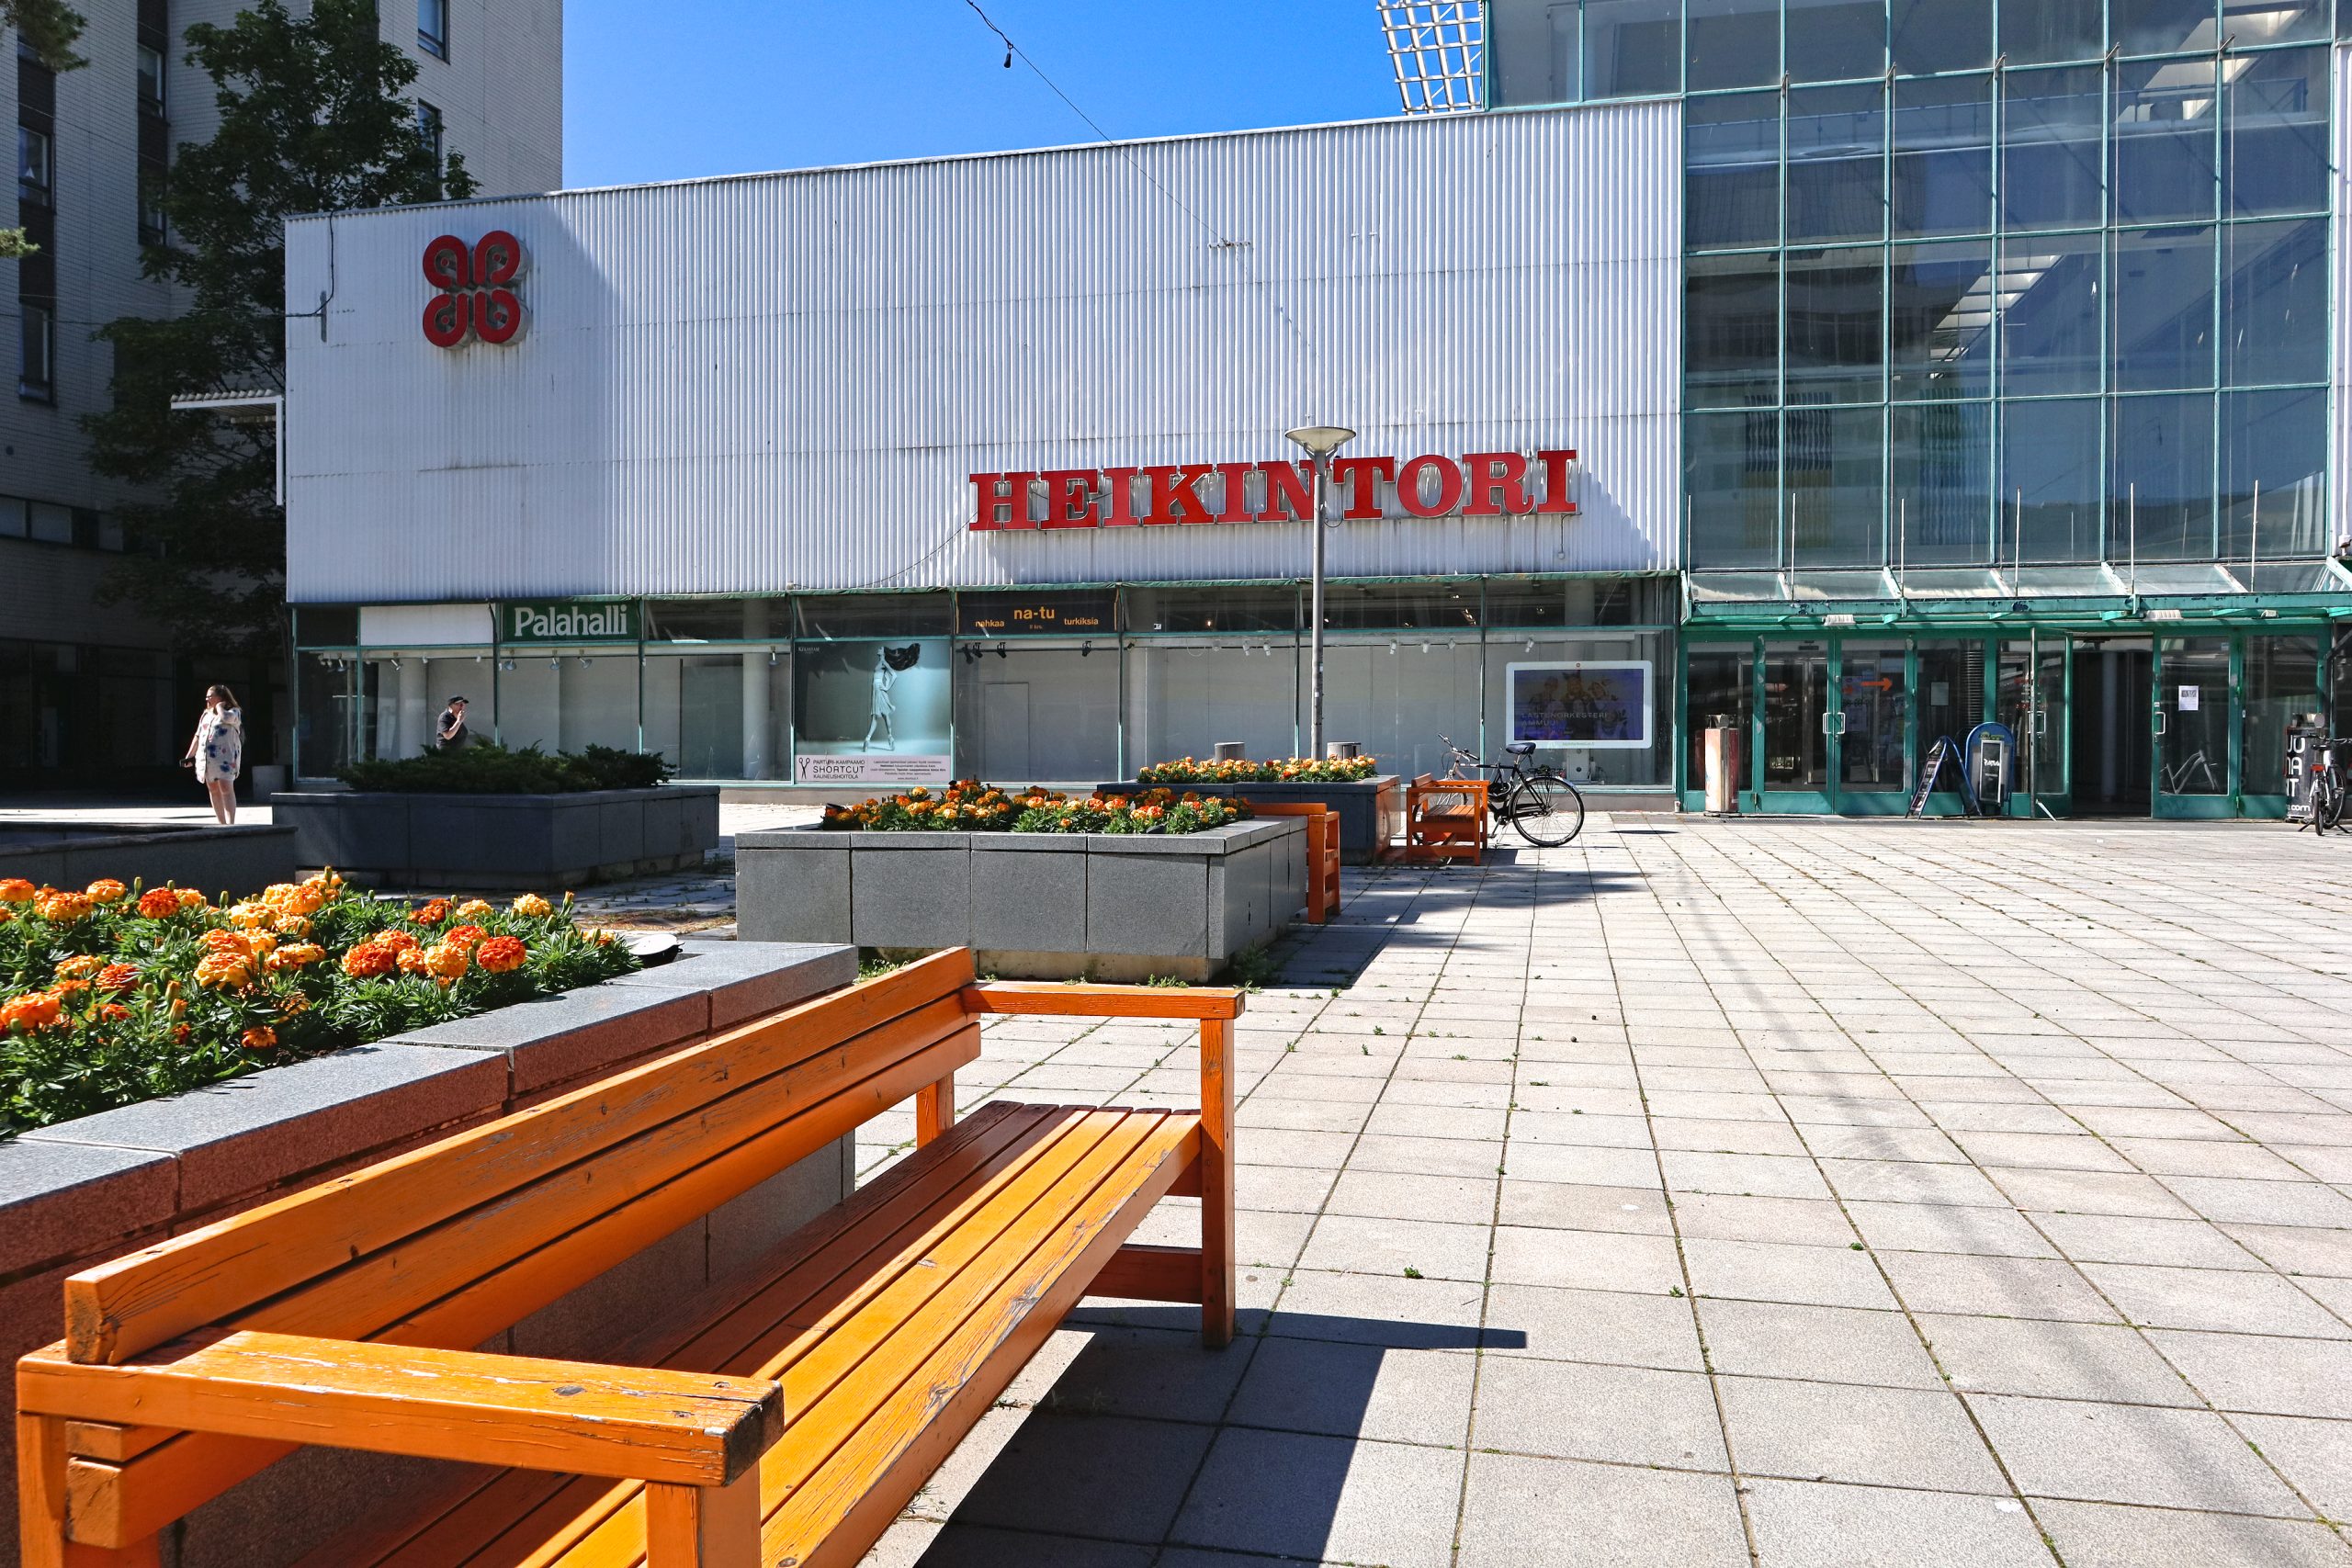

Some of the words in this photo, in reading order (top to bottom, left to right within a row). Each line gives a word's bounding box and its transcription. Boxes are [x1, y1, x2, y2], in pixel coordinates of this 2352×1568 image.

[969, 450, 1577, 531] HEIKINTORI
[1013, 606, 1056, 620] na-tu
[514, 604, 628, 637] Palahalli
[975, 619, 1005, 627] nahkaa
[1064, 616, 1099, 626] turkiksia
